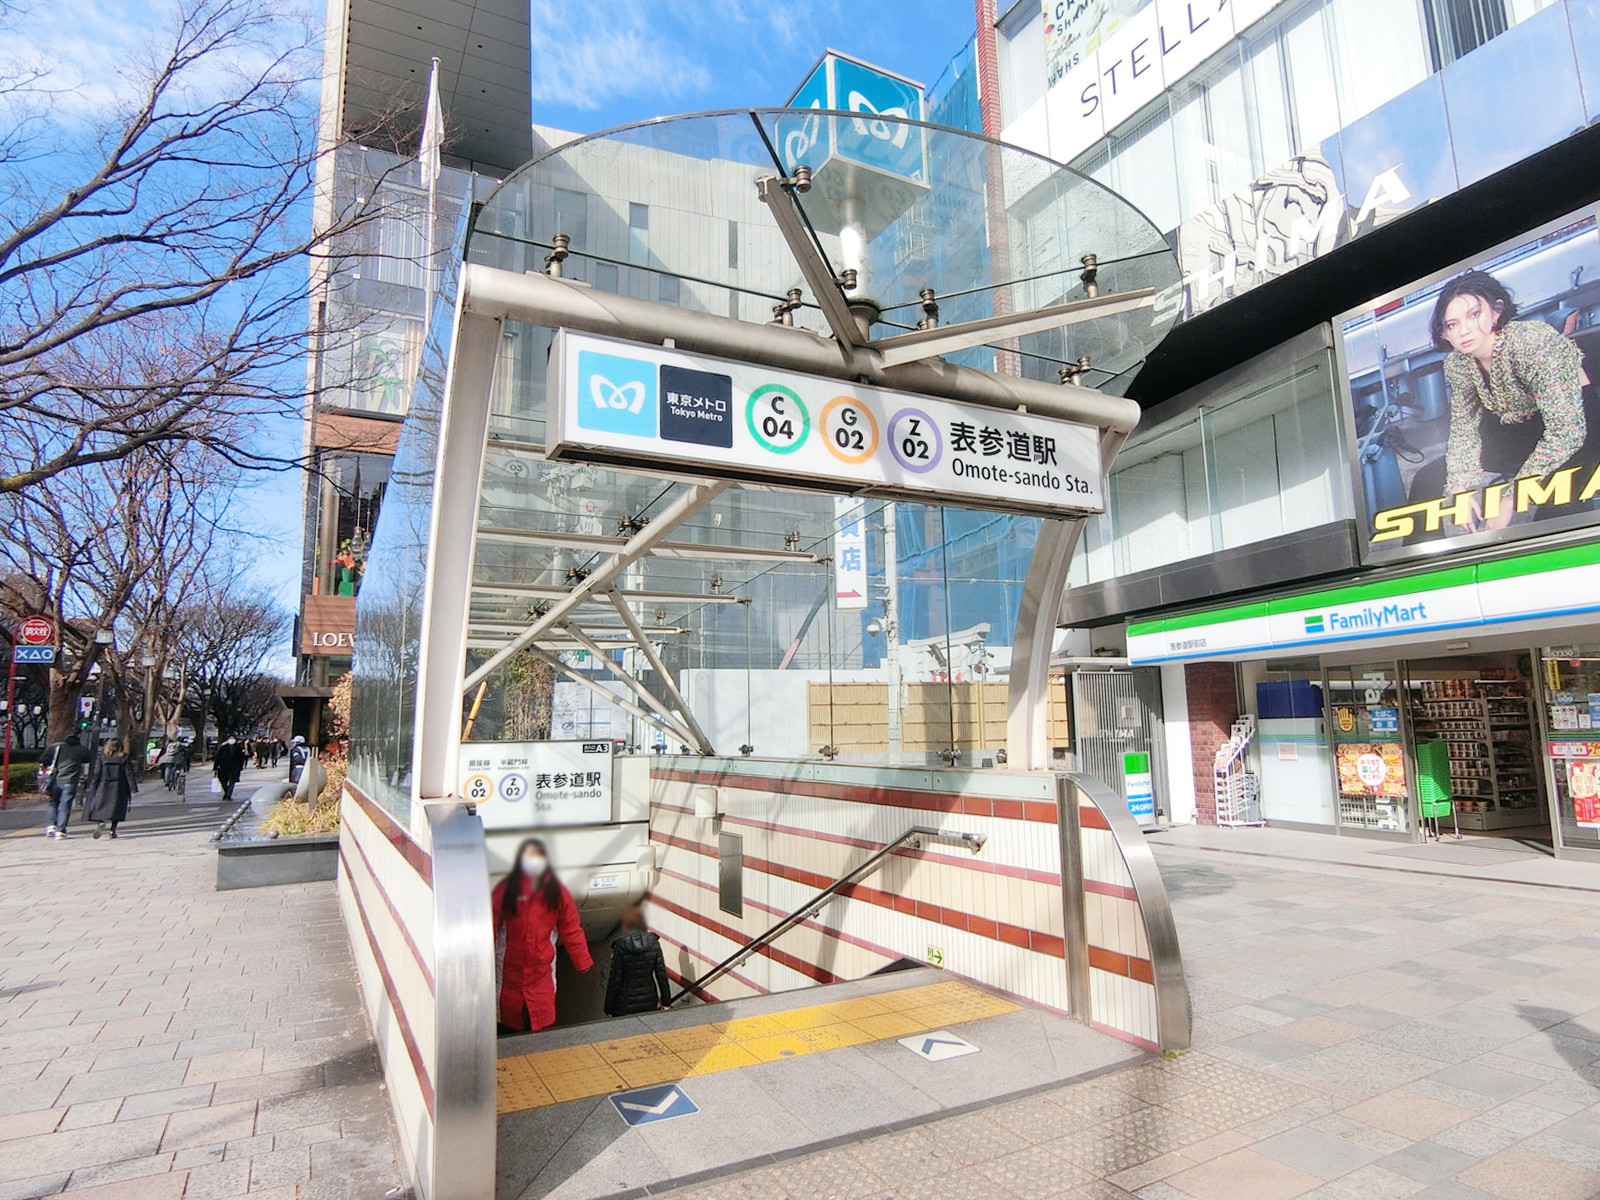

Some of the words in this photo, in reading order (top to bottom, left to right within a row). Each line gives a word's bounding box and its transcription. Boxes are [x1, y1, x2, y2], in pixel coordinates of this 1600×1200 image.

[1081, 0, 1227, 118] STELL
[666, 392, 727, 412] 東京メトロ
[771, 396, 785, 415] C
[670, 406, 696, 419] Tokyo
[697, 410, 723, 422] Metro
[841, 408, 858, 426] G
[763, 416, 794, 439] 04
[909, 419, 921, 436] Z
[836, 428, 864, 450] 02
[950, 422, 1058, 466] 表参道駅
[903, 438, 929, 459] 02
[952, 458, 1060, 490] Omote-sando
[1065, 475, 1094, 494] Sta.
[1329, 602, 1427, 630] FamilyMart
[596, 744, 608, 752] A3
[475, 779, 483, 787] G
[511, 778, 516, 786] Z
[535, 772, 601, 789] 表参道駅
[472, 789, 486, 797] 02
[506, 787, 520, 796] 02
[536, 789, 602, 800] Omote-sando
